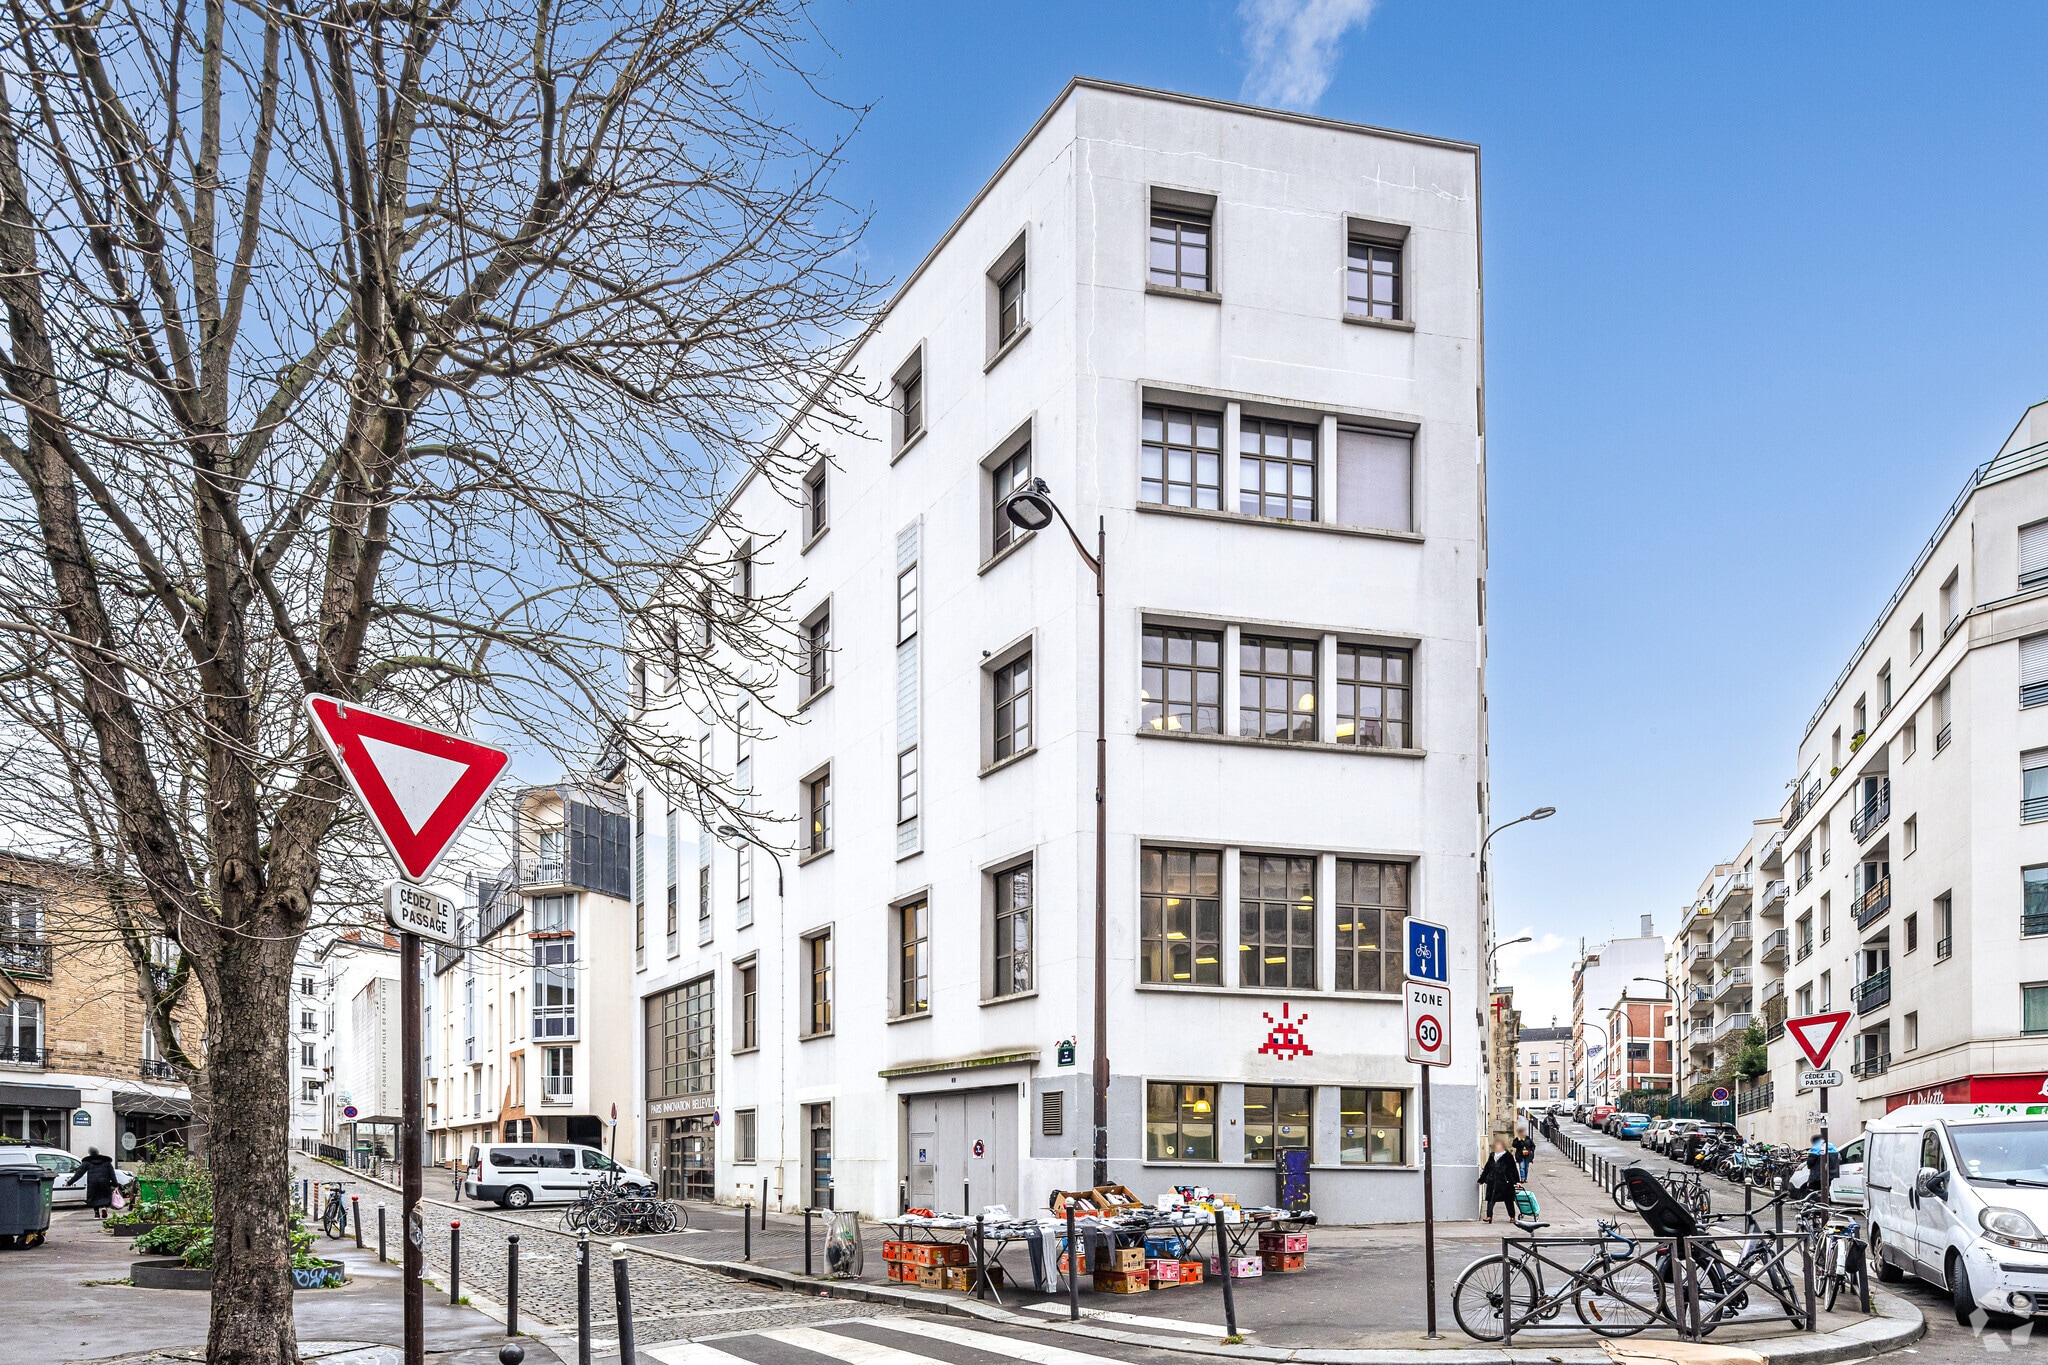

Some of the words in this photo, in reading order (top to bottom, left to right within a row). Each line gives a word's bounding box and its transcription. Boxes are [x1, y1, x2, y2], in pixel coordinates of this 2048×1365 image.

[400, 888, 432, 912] CÉDEZ
[437, 901, 449, 918] LE
[402, 907, 448, 935] PASSAGE
[1414, 991, 1443, 1007] ZONE
[1421, 1024, 1437, 1042] 30
[650, 1104, 662, 1114] PARIS
[663, 1100, 691, 1113] INNOVATION
[692, 1096, 716, 1110] BELLEVILL
